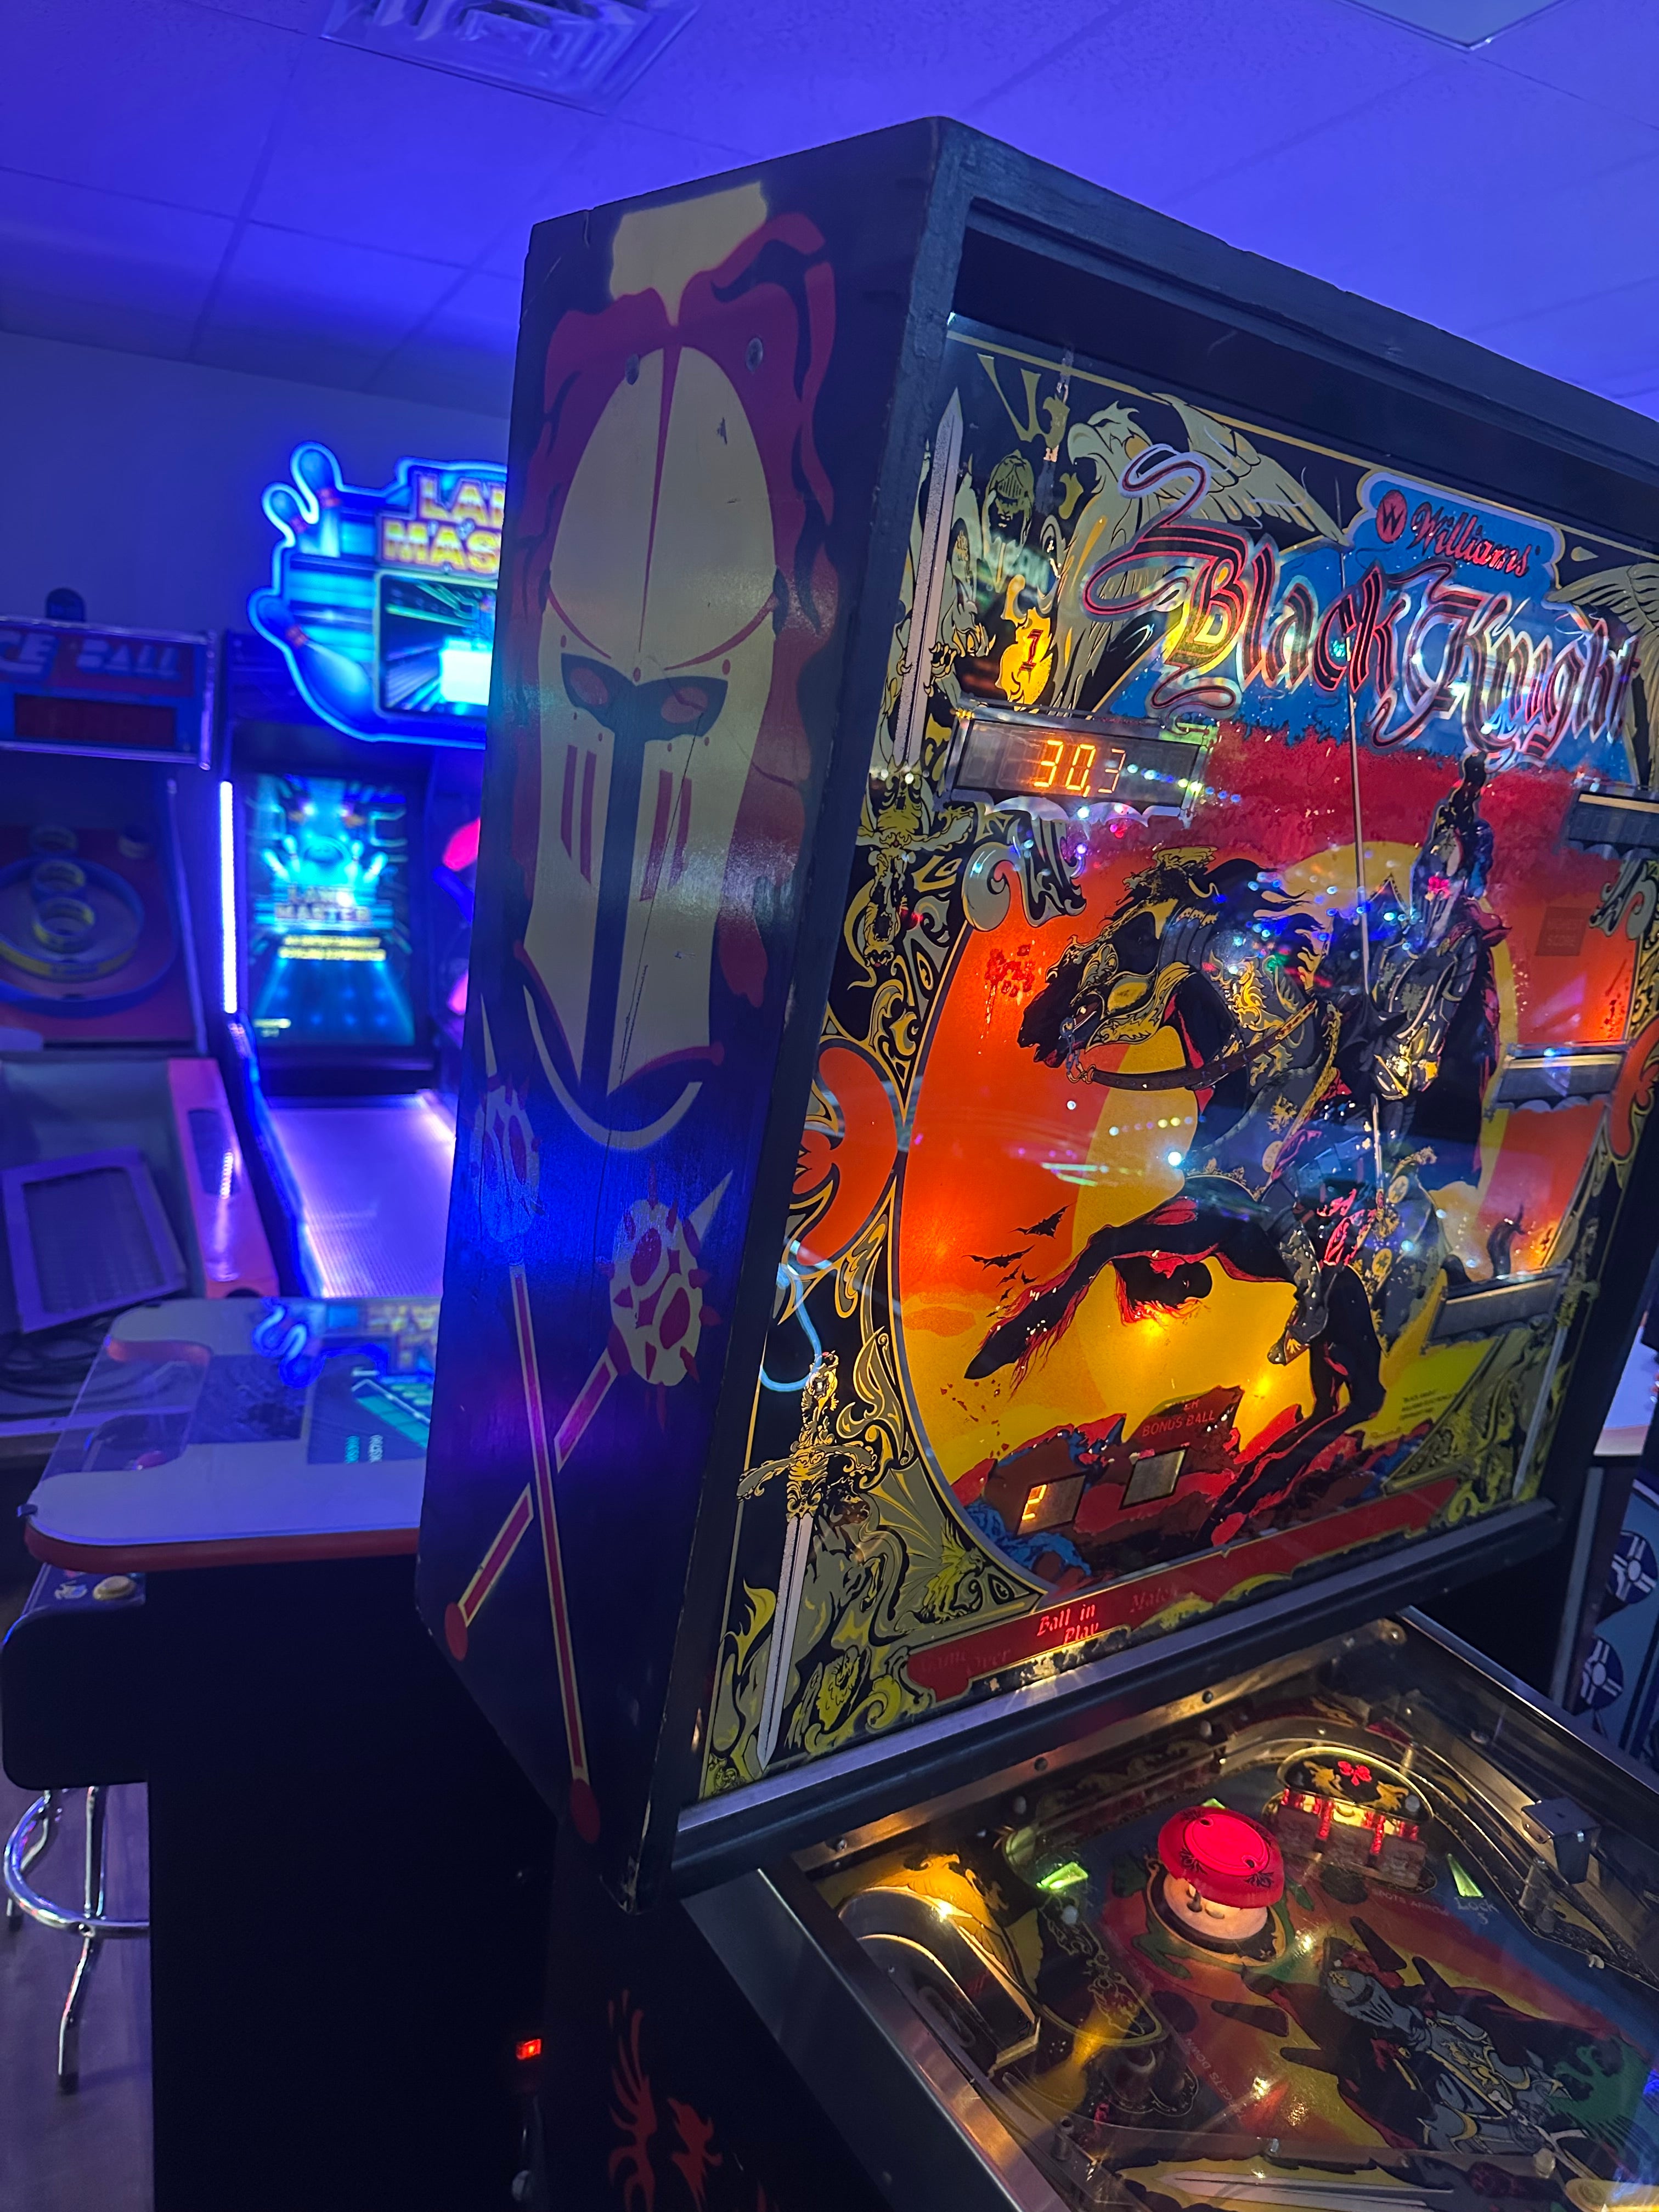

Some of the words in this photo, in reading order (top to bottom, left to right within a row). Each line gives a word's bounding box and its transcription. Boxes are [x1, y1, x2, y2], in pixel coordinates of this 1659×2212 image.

[1408, 501, 1532, 577] Williams
[1081, 450, 1407, 712] Black
[75, 636, 179, 678] BALL
[1366, 560, 1641, 761] Knight
[1142, 1416, 1183, 1437] BONUS
[1186, 1409, 1216, 1426] BALL
[1036, 1608, 1070, 1637] Ball
[1079, 1603, 1096, 1622] in
[1453, 1894, 1500, 1914] Lock
[1184, 2037, 1212, 2069] DOWN
